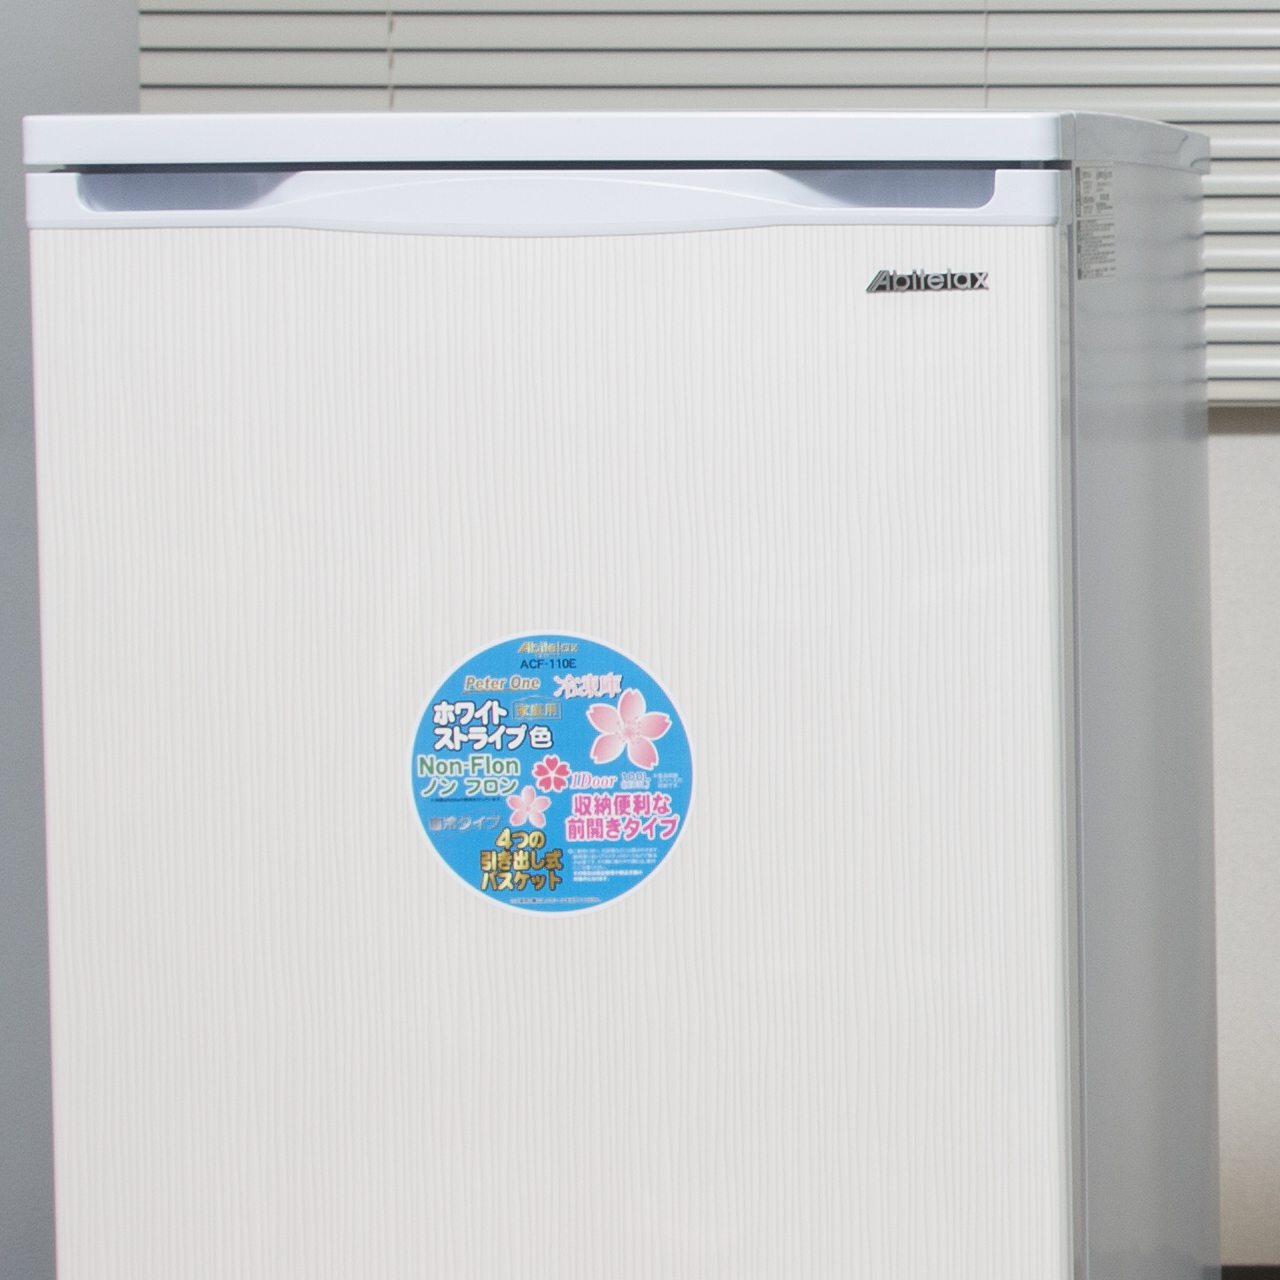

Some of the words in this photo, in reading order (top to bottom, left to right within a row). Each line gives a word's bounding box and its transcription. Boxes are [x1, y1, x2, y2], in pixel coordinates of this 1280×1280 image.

[866, 269, 989, 293] Abitelax
[518, 641, 578, 654] Abitelax
[520, 658, 577, 669] ACF-110E
[465, 675, 506, 693] Peter
[510, 674, 540, 691] One
[553, 671, 622, 699] 冷凍庫
[433, 700, 508, 726] ホワイト
[433, 724, 553, 751] ストライプ色
[418, 754, 520, 776] Non-Flon
[572, 792, 672, 817] 収納便利な
[495, 828, 546, 849] 4つの
[565, 814, 680, 841] 前開きタイプ
[480, 849, 563, 871] 引き出し式
[481, 871, 562, 891] バスケット
